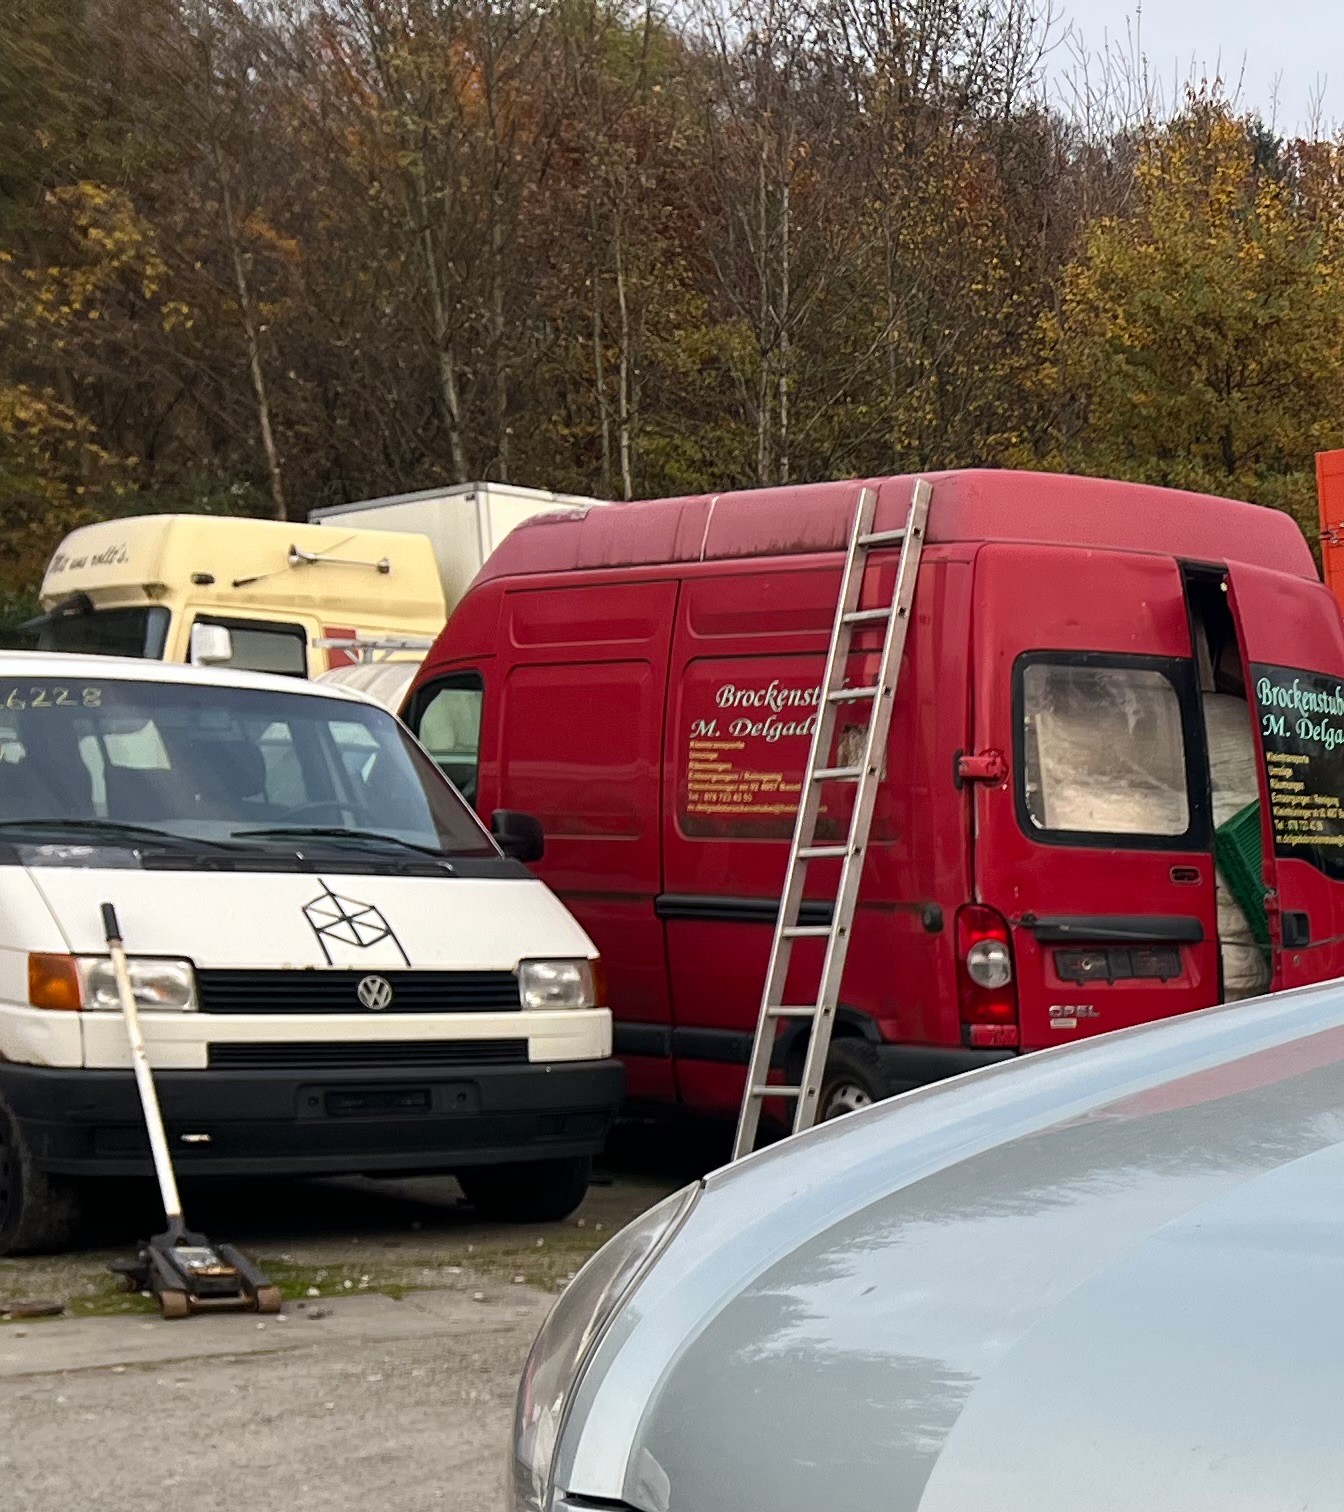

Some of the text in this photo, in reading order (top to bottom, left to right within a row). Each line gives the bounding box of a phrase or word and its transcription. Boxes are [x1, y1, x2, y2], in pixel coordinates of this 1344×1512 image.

[689, 718, 721, 738] M.
[1262, 713, 1291, 737] M.
[1048, 1004, 1101, 1019] OPEL
